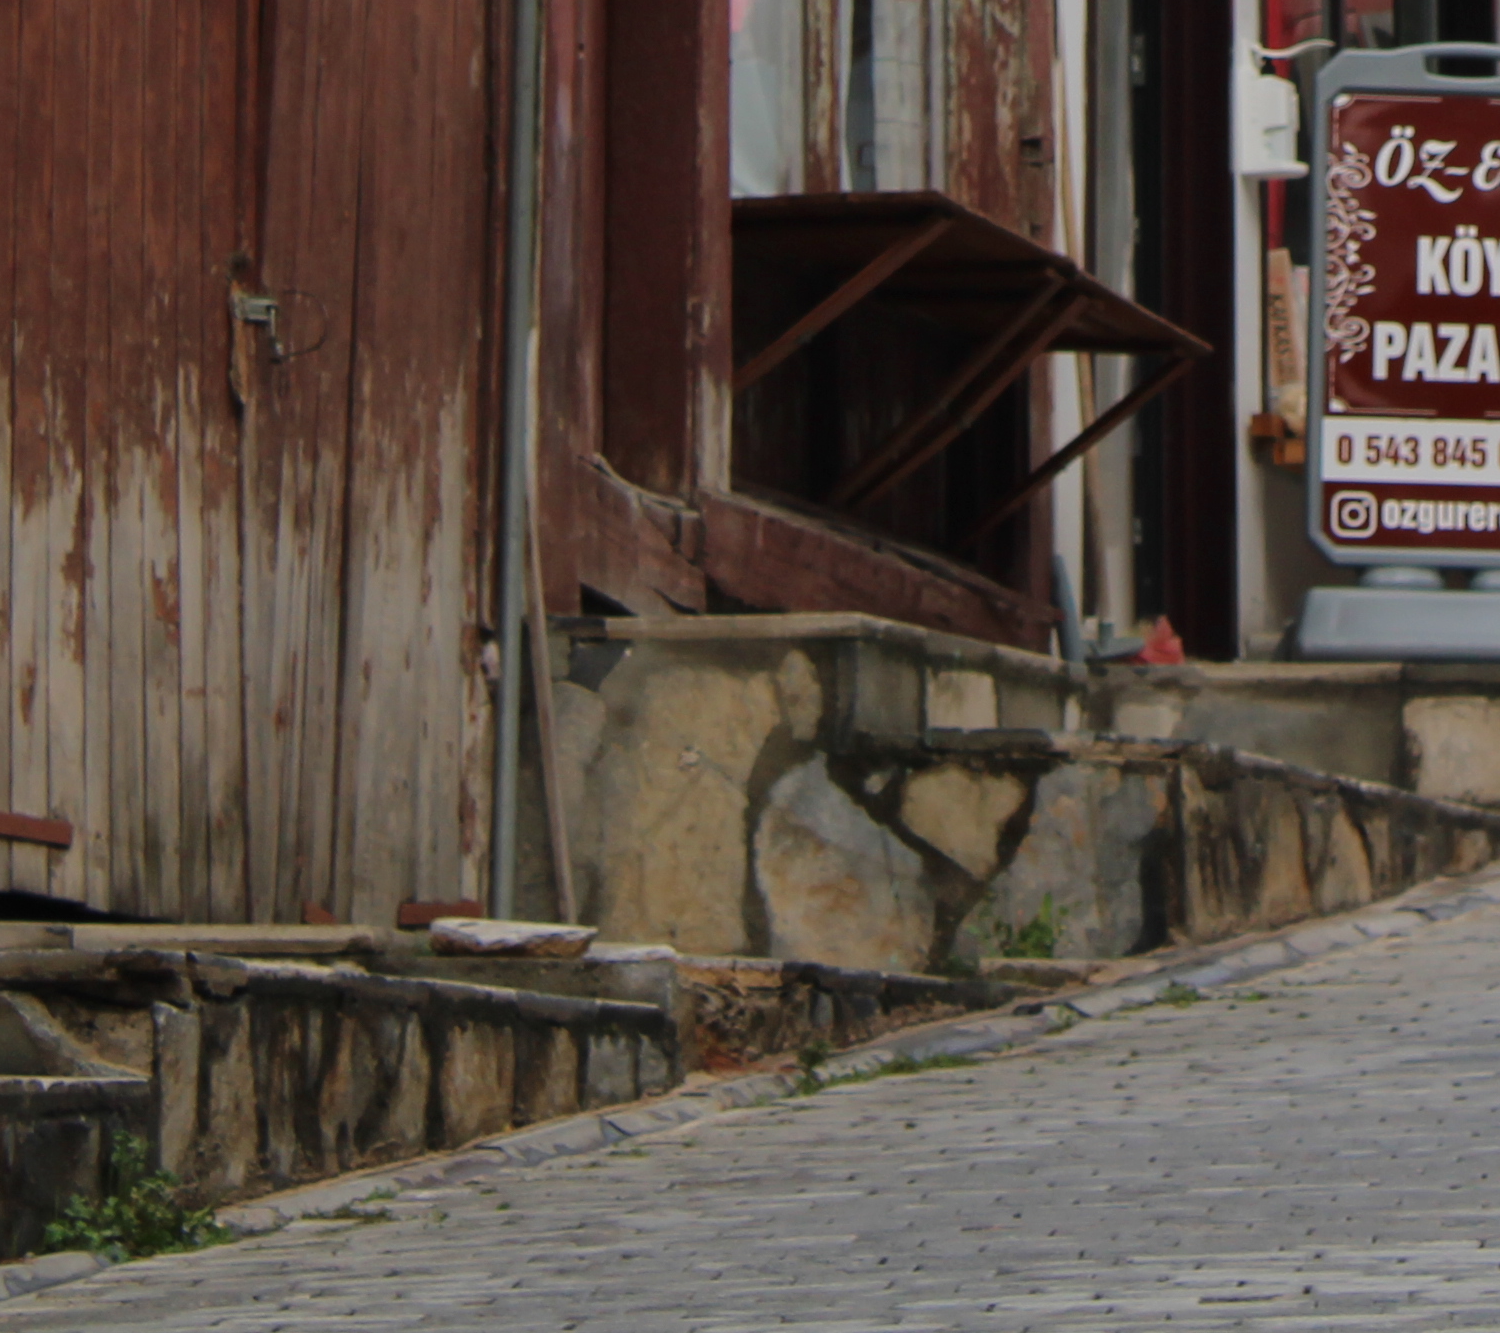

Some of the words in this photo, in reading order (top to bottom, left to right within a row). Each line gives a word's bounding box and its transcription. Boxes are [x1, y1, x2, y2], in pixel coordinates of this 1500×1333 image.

[1337, 435, 1352, 464] 0
[1364, 435, 1420, 466] 543
[1431, 436, 1487, 468] 845
